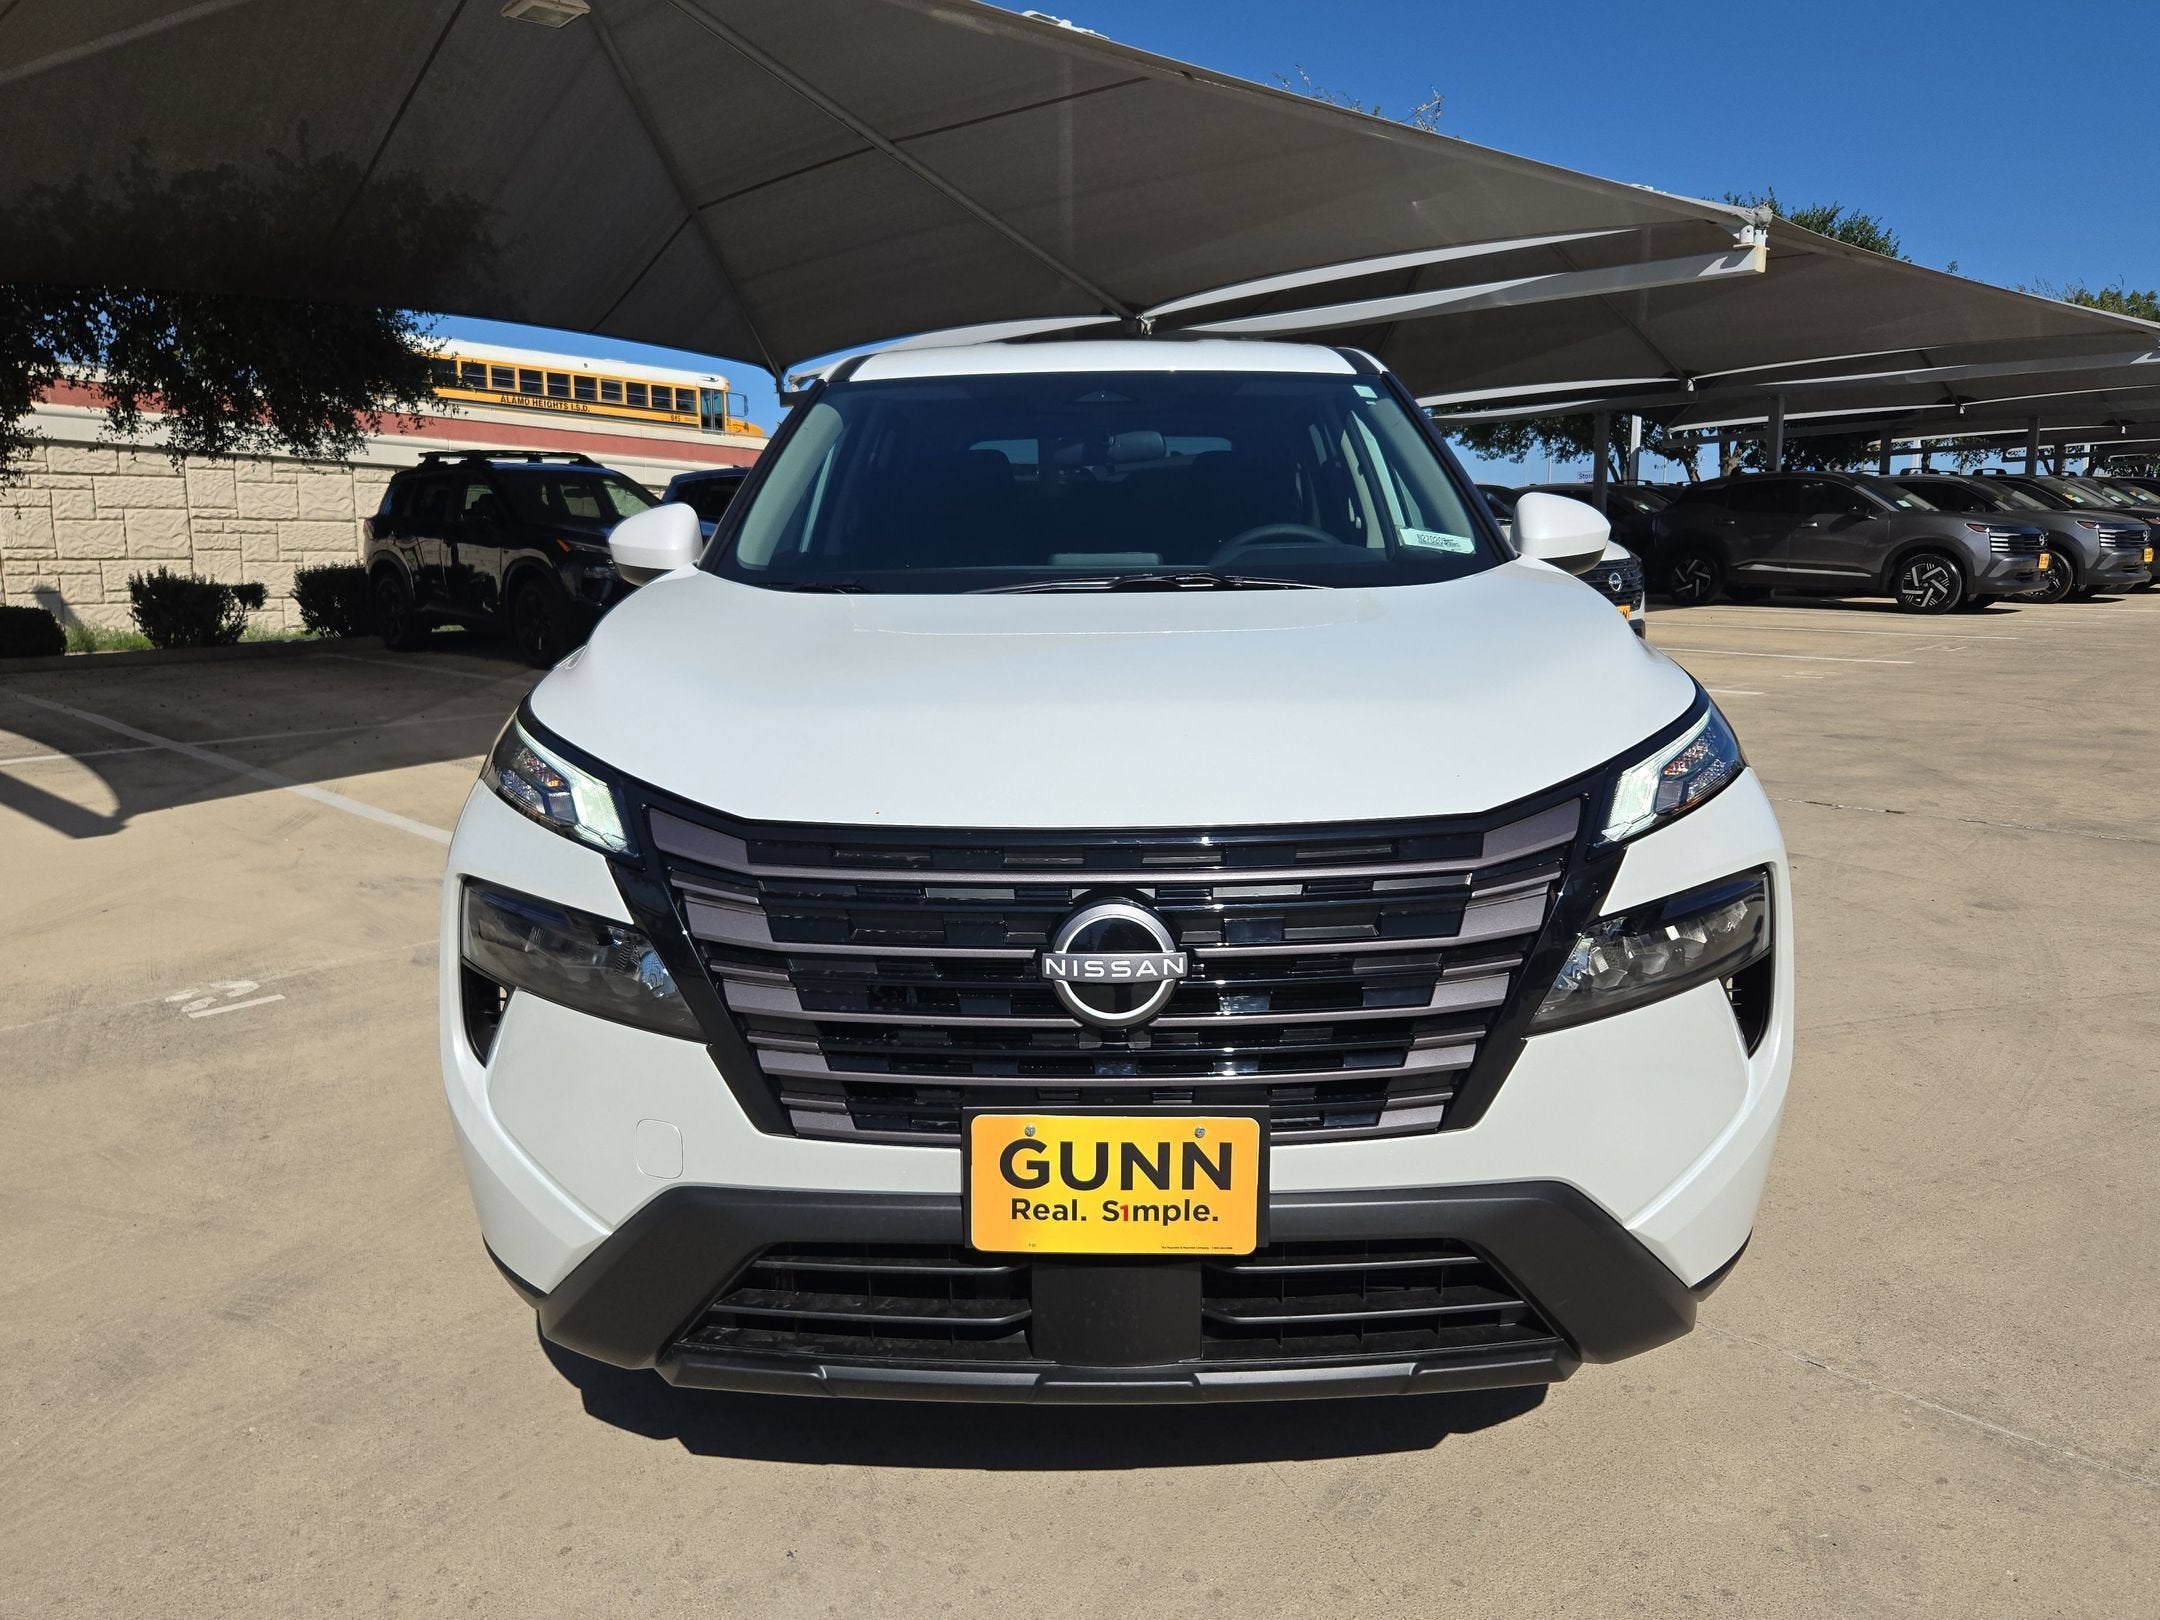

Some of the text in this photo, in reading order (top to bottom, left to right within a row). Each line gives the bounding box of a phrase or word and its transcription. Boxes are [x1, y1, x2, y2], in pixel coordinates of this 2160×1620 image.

[501, 395, 530, 406] ALAMO
[532, 398, 569, 410] HEIGHTS
[1045, 957, 1184, 978] NISSAN
[999, 1138, 1233, 1191] GUNN
[1011, 1197, 1219, 1227] Real. S1mple.
